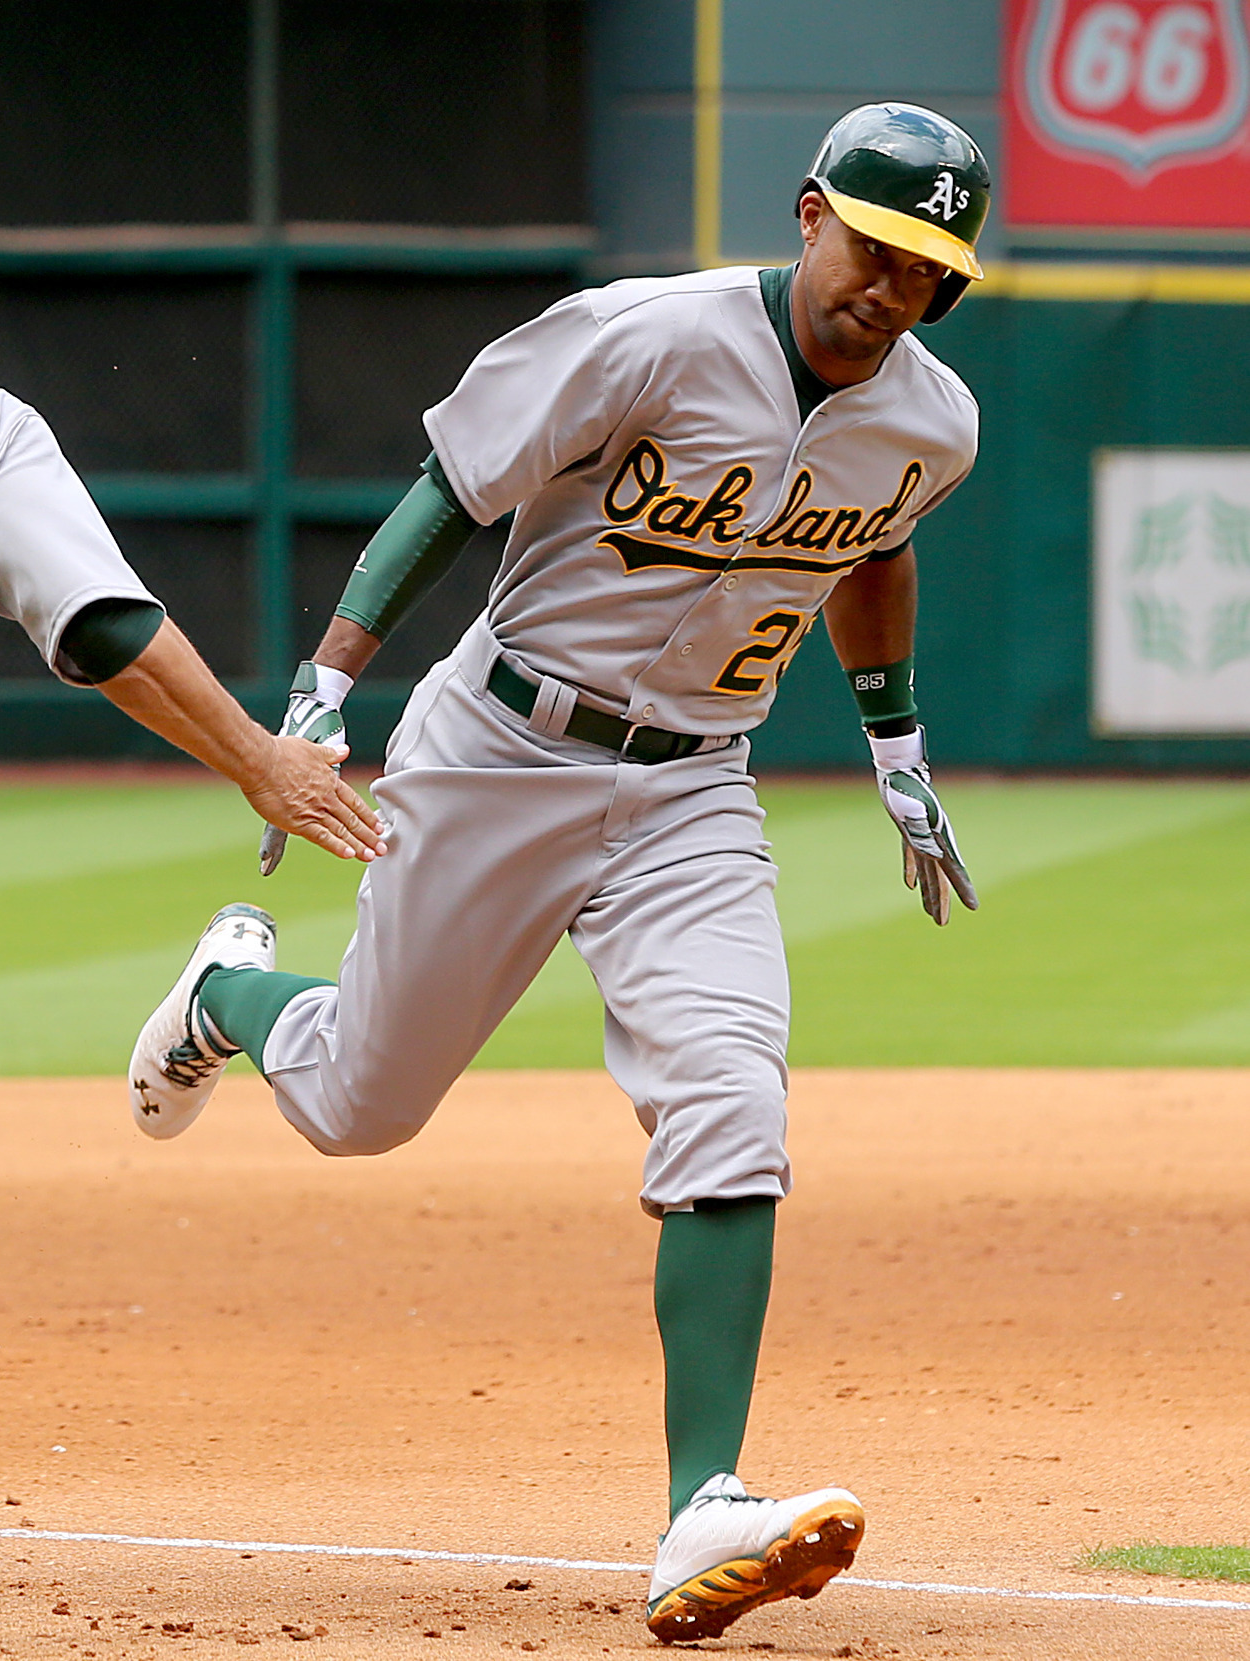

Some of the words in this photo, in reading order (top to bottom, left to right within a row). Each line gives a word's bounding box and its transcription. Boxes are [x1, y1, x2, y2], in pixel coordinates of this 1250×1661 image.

[1065, 3, 1211, 113] 66
[602, 436, 923, 553] Oakland
[855, 673, 885, 690] 25
